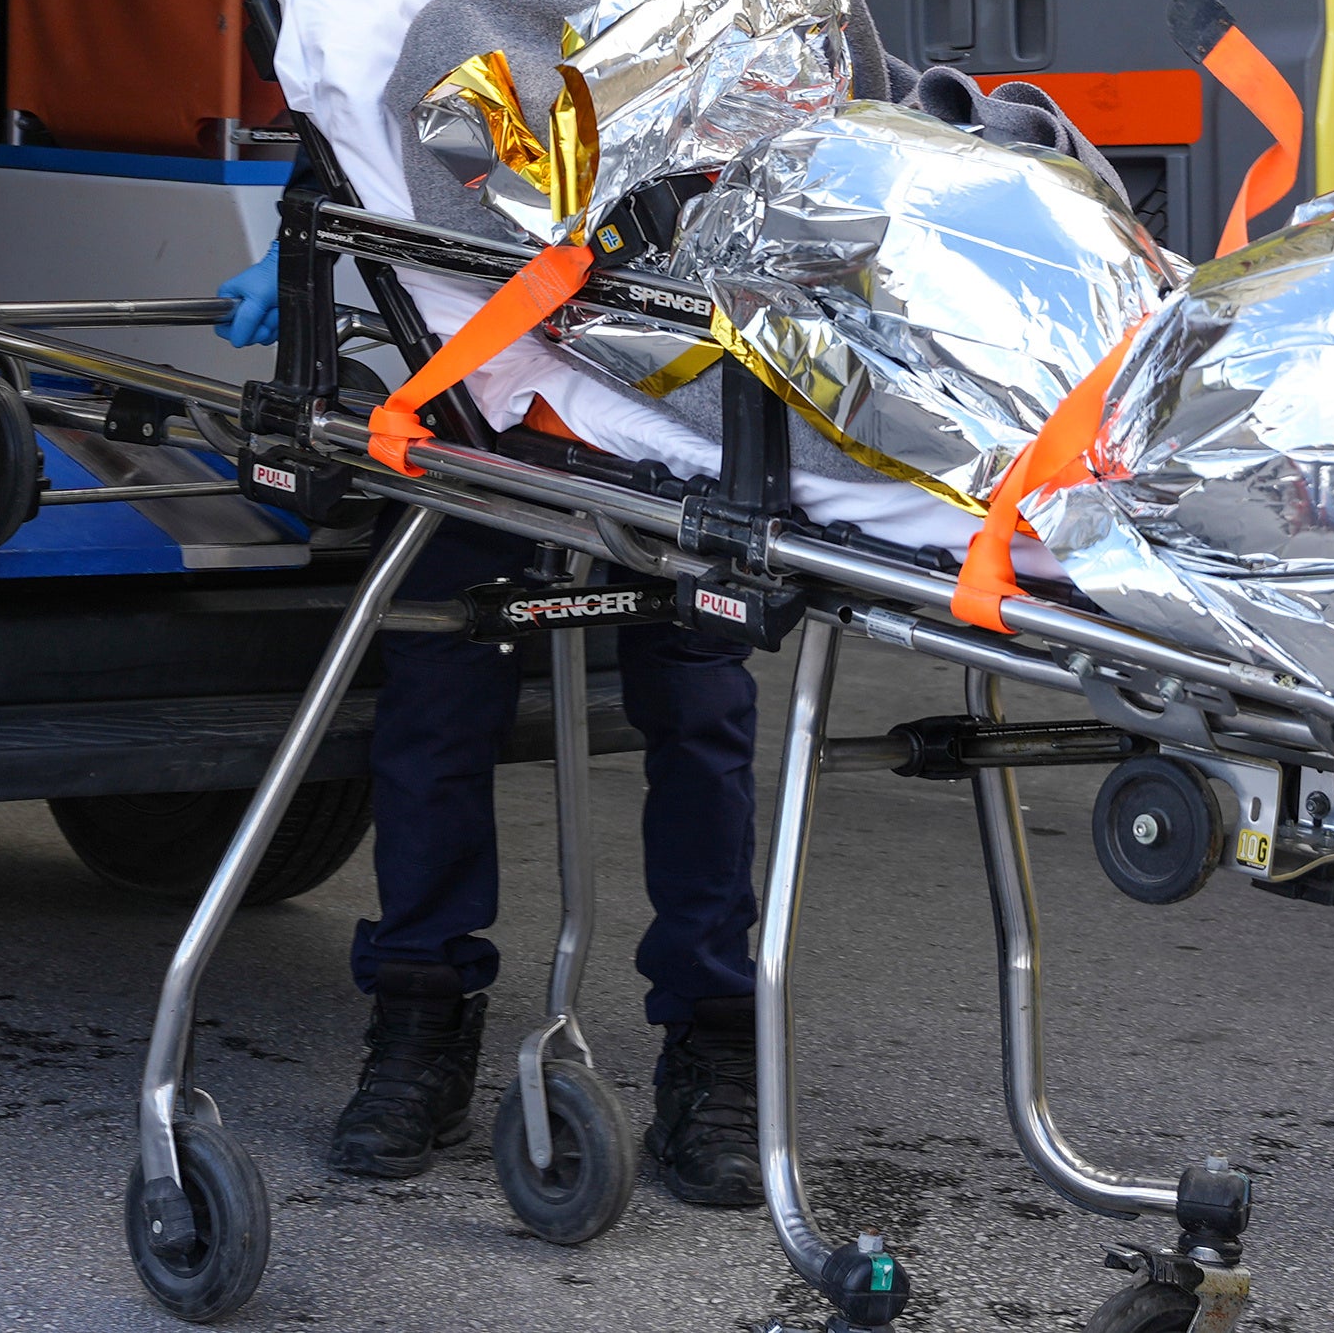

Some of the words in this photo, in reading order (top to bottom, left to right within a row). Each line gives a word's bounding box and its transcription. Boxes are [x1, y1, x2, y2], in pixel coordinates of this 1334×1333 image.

[257, 467, 292, 488] PULL
[509, 591, 637, 623] SPENCER
[701, 593, 741, 618] PULL
